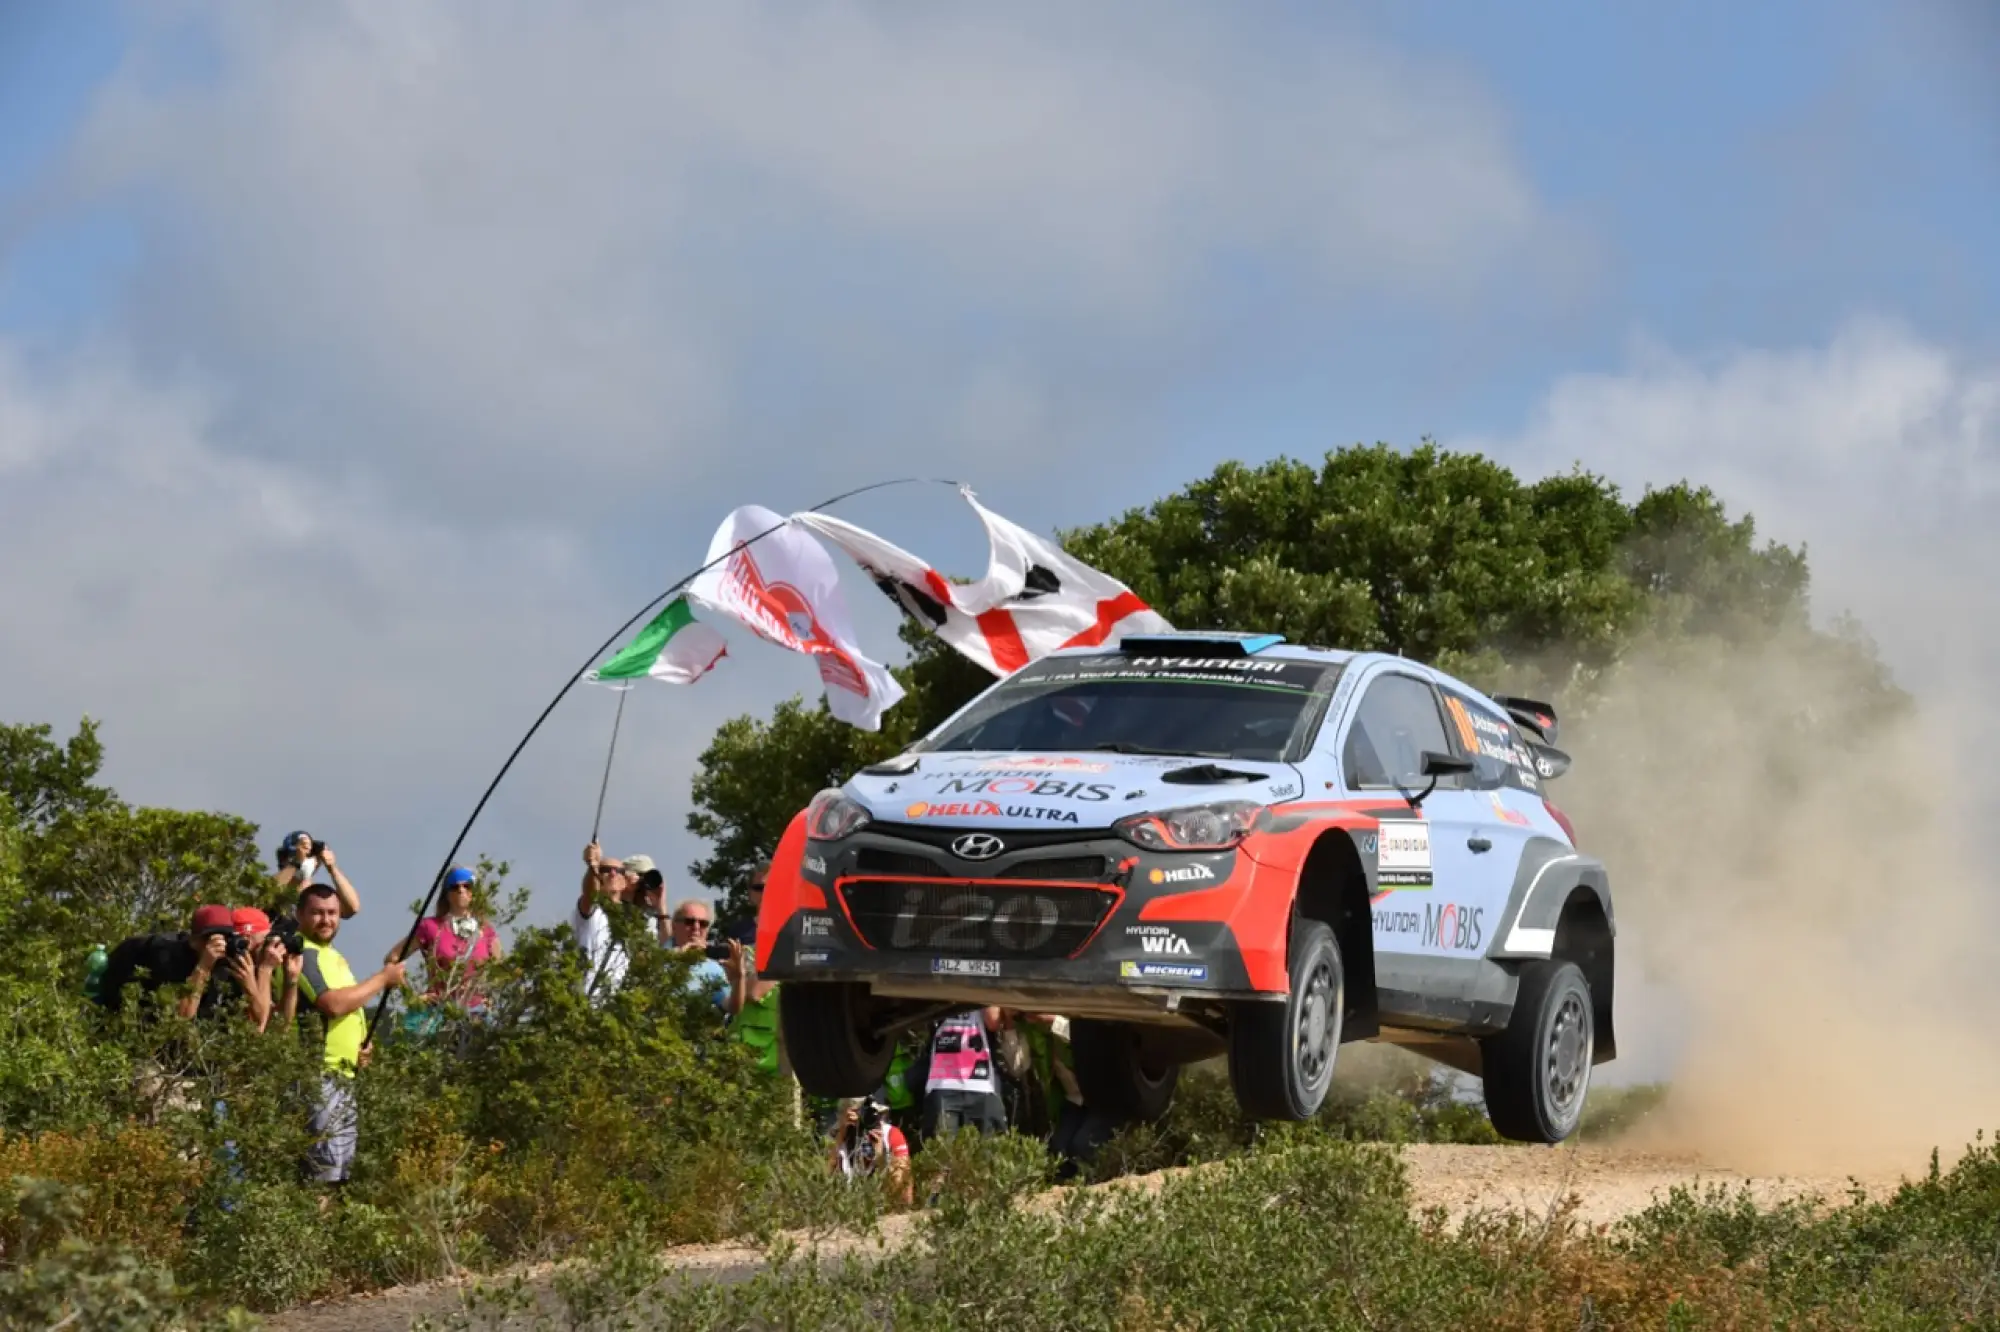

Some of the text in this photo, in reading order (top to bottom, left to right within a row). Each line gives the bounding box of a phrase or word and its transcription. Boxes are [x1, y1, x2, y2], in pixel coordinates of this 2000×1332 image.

[1132, 656, 1287, 673] HYUNDAI
[937, 777, 1117, 802] MOBIS
[927, 799, 1079, 824] HELIX ULTRA
[1163, 862, 1216, 882] HELIX
[890, 888, 1059, 951] i20
[1125, 925, 1170, 936] HYUNDAI
[1372, 902, 1484, 951] HYUNDAI MOBIS
[1143, 964, 1204, 978] MICHELIN
